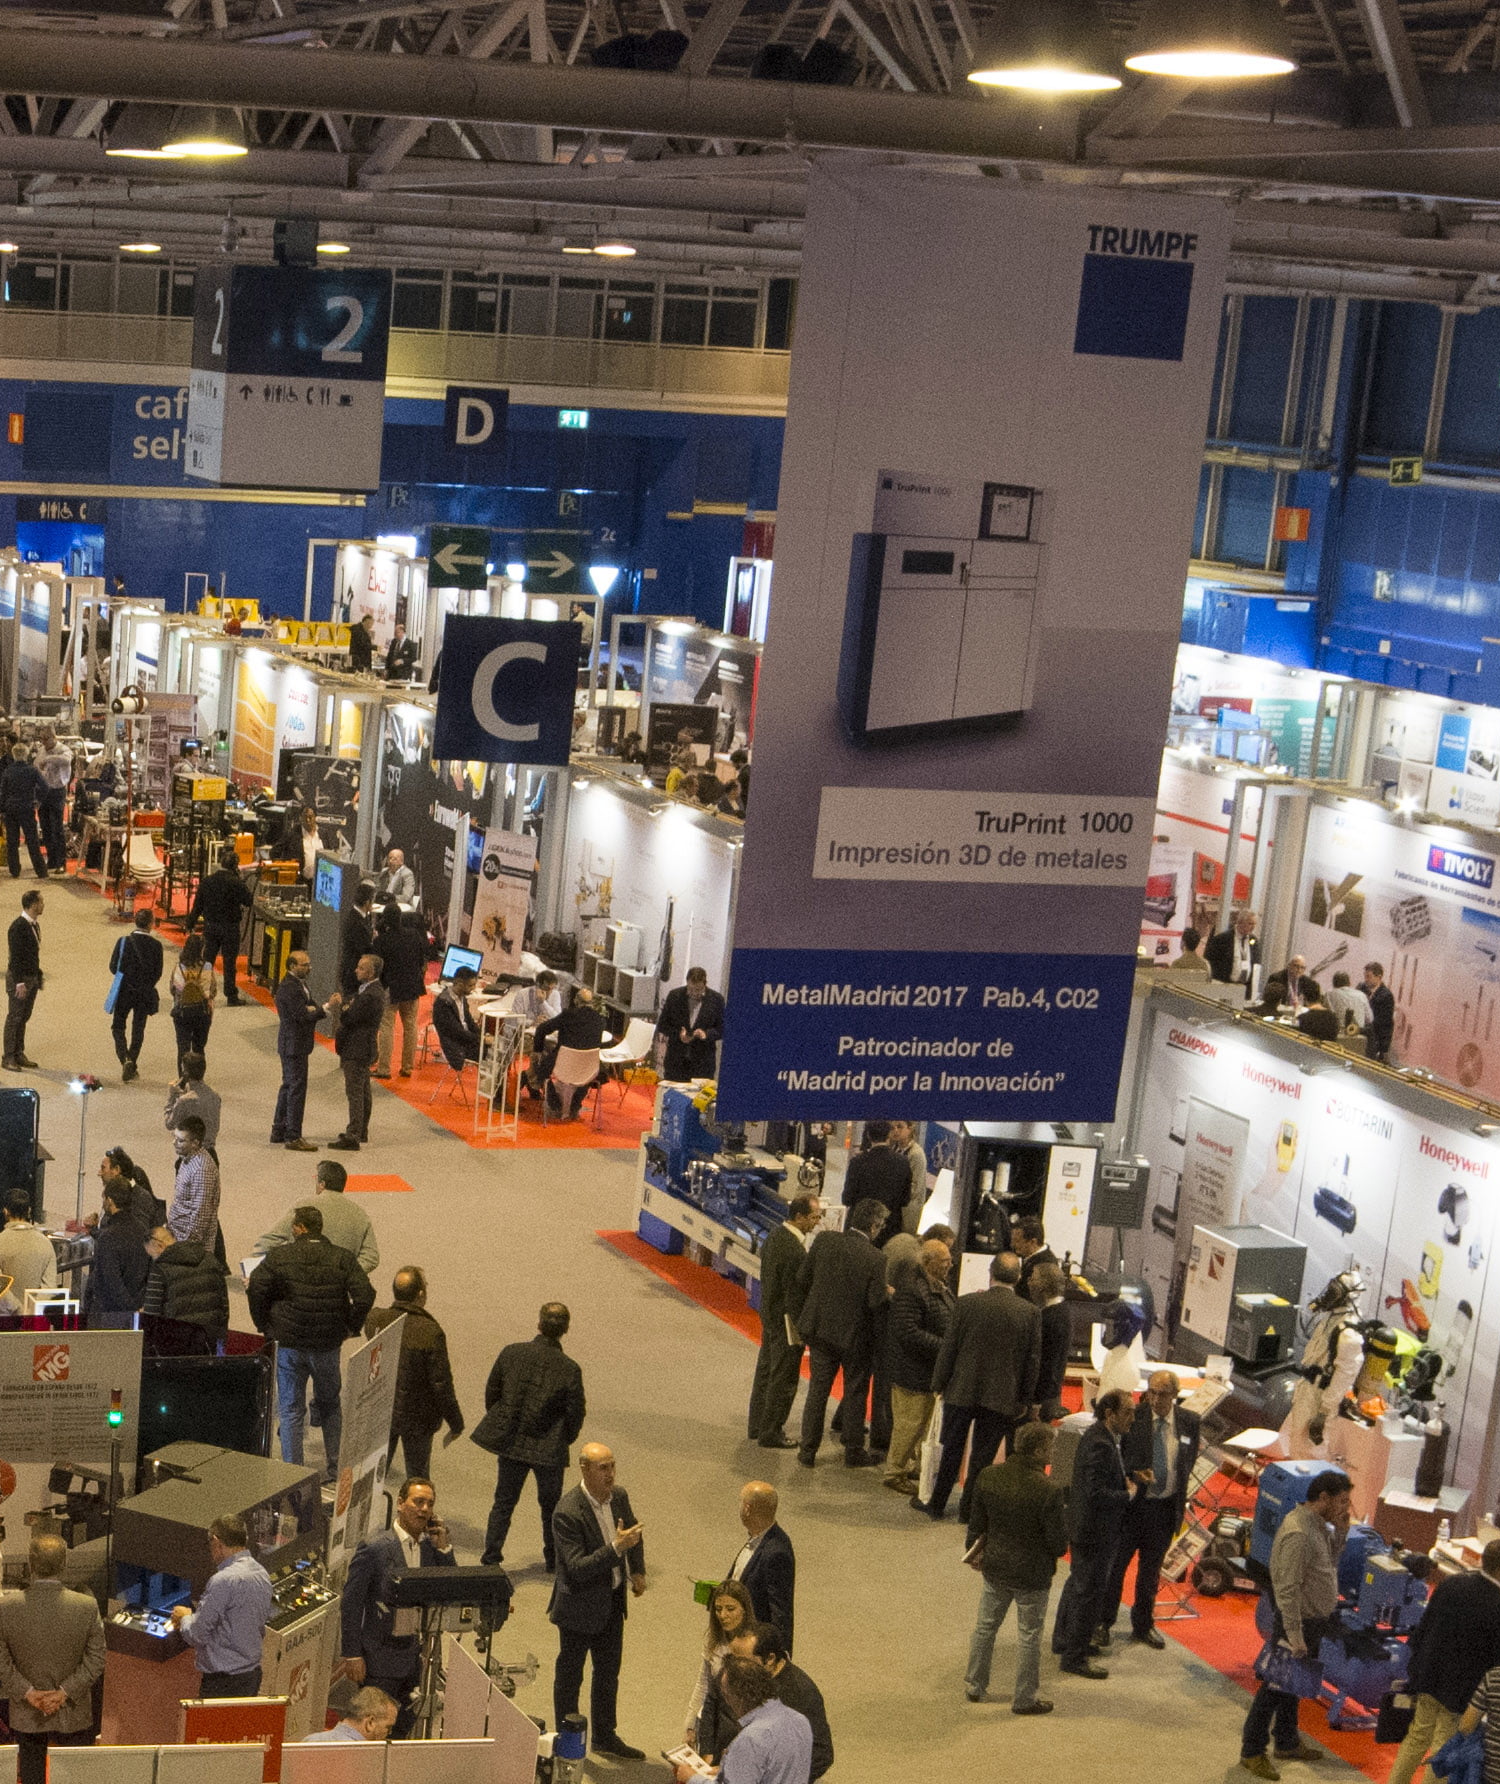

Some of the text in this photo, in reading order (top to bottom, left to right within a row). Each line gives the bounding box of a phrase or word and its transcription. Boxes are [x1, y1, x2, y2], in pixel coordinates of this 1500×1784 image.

[1086, 225, 1199, 260] TRUMPF
[320, 296, 364, 363] 2
[455, 397, 495, 446] D
[471, 641, 549, 742] C
[973, 810, 1134, 836] TruPrint 1000
[828, 838, 1128, 871] Impresión 3D de metales
[1443, 851, 1492, 882] TIVOLY
[761, 983, 1101, 1012] MetalMadrid 2017 Pab.4, C02
[837, 1035, 1015, 1060] Patrocinador de
[1167, 1028, 1218, 1060] CHAMPION
[869, 1074, 905, 1097] por
[911, 1071, 933, 1093] la
[1241, 1063, 1302, 1100] Honeywell
[1334, 1100, 1394, 1140] BOTTARINI
[1419, 1134, 1490, 1180] Honeywell
